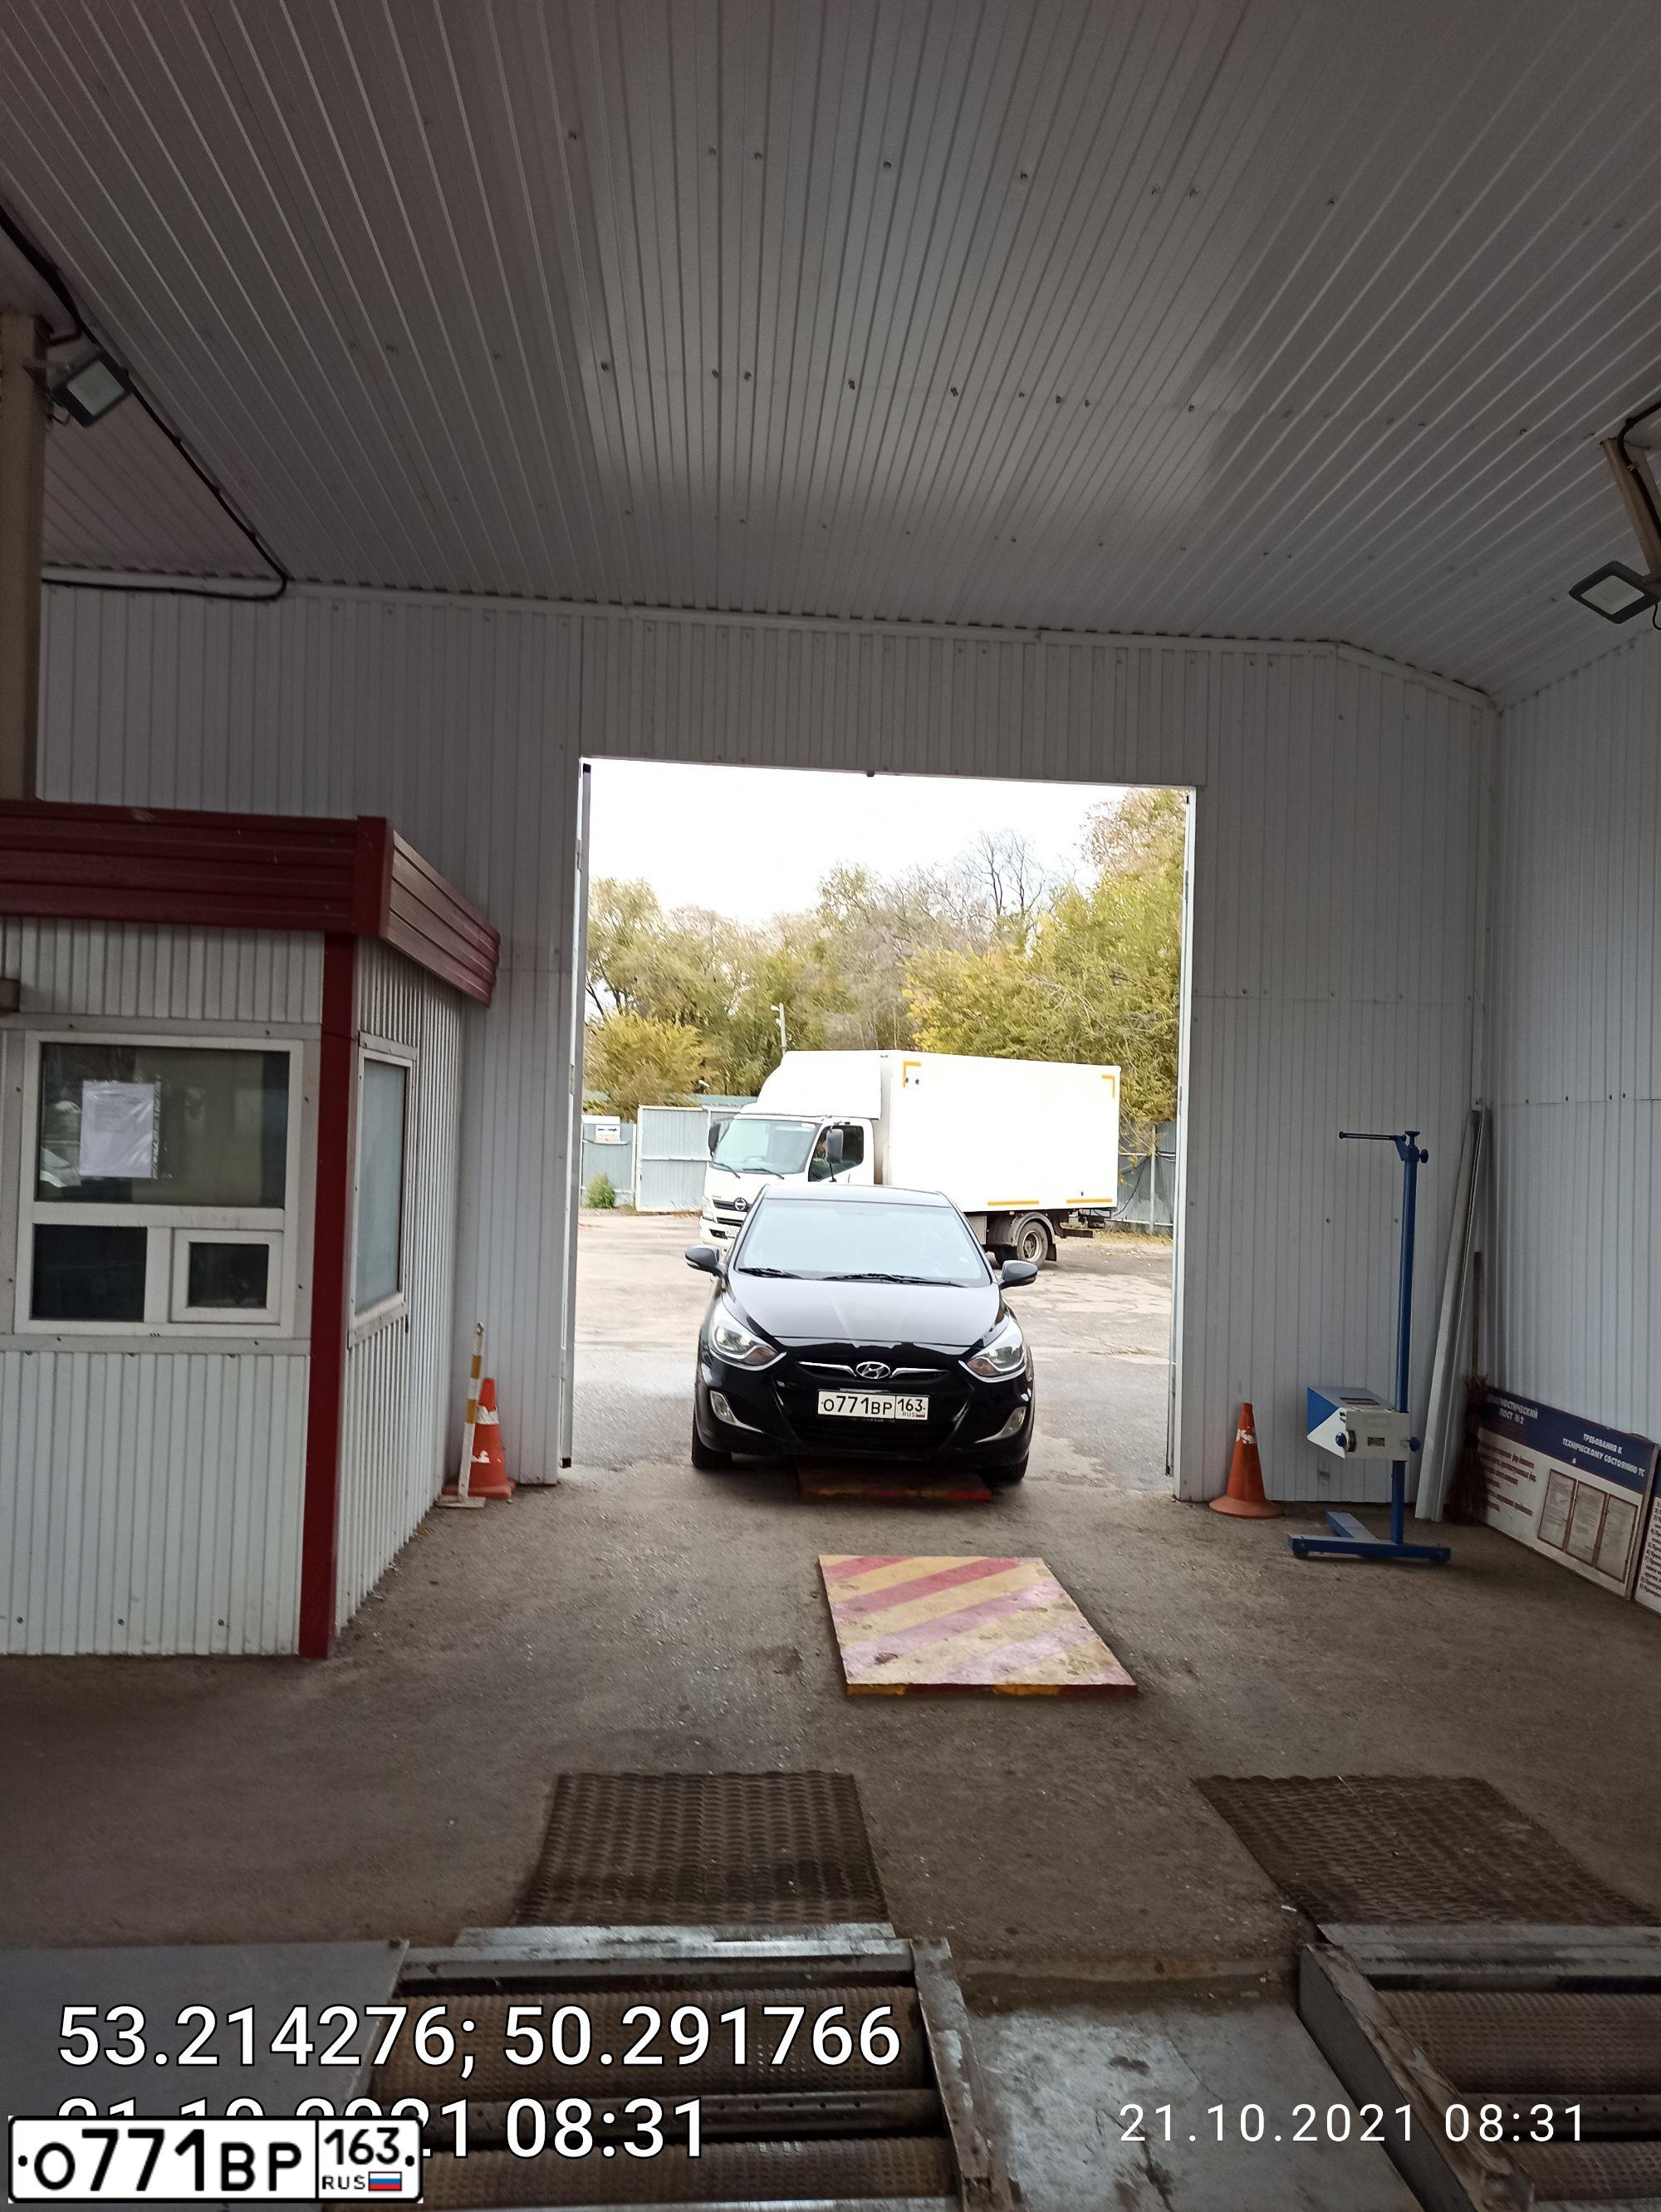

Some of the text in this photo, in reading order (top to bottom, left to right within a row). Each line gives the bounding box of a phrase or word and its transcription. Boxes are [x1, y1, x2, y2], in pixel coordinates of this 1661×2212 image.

[823, 1395, 923, 1415] О771ВР 163
[1487, 1394, 1538, 1419] АГНОСТИЧЕСКИЙ
[1583, 1433, 1623, 1454] ТРЕБОВАНИЯ К
[1562, 1438, 1646, 1477] ТЕХНИЧЕСКОМУ СОСТОЯНИЮ ТС
